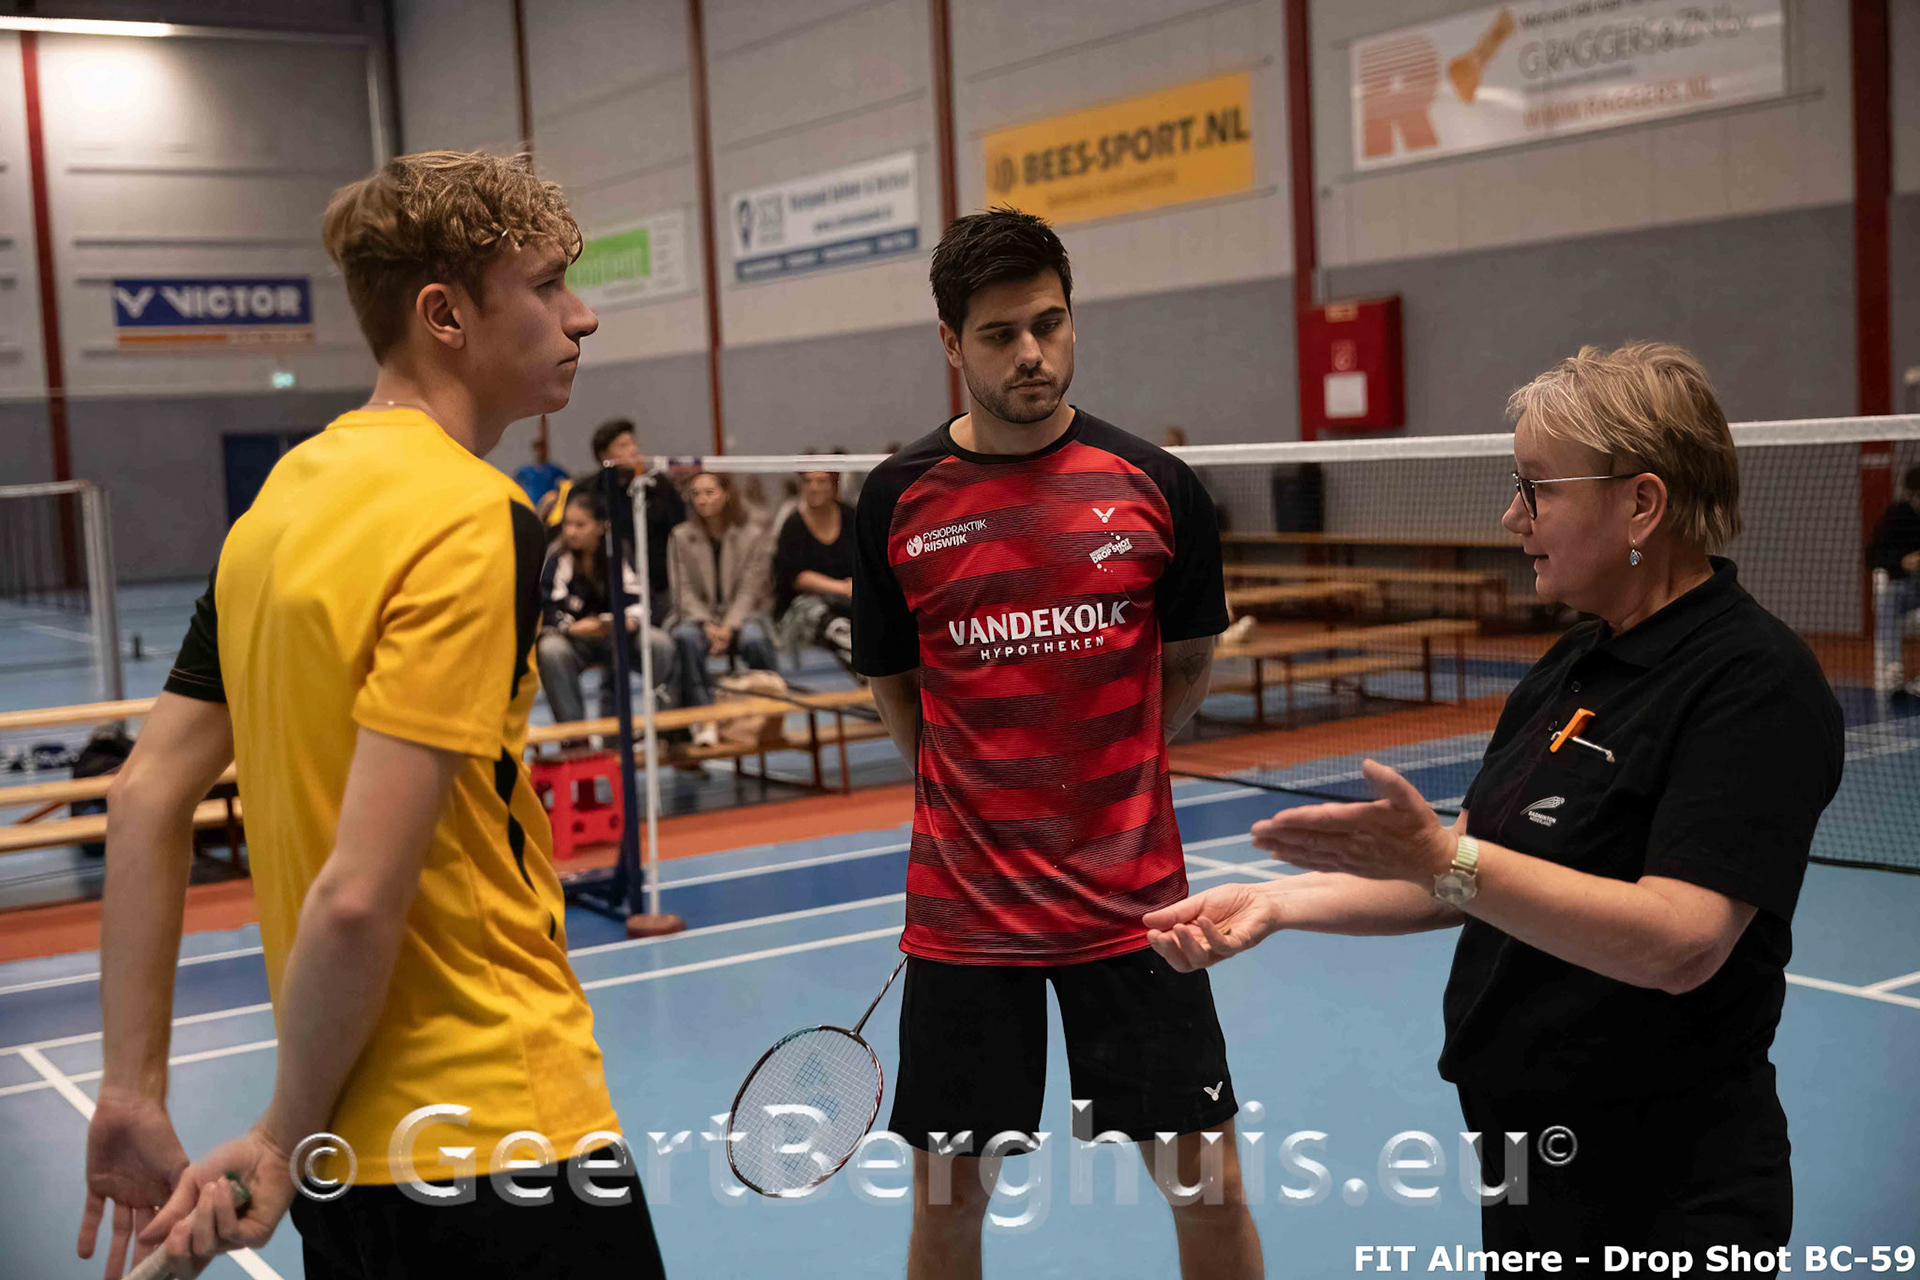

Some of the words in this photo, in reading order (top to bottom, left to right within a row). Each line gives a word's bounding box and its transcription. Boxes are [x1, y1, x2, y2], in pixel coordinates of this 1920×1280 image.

[1022, 104, 1251, 188] BEES-SPORT.NL
[160, 285, 301, 318] VICTOR
[921, 518, 988, 543] FYSIOPRAKTIJK
[923, 533, 969, 553] RIJSWIJK
[1092, 548, 1112, 564] DROP
[1111, 537, 1131, 553] SHOT
[948, 600, 1130, 647] VANDEKOLK
[980, 635, 1105, 661] HYPOTHEKEN
